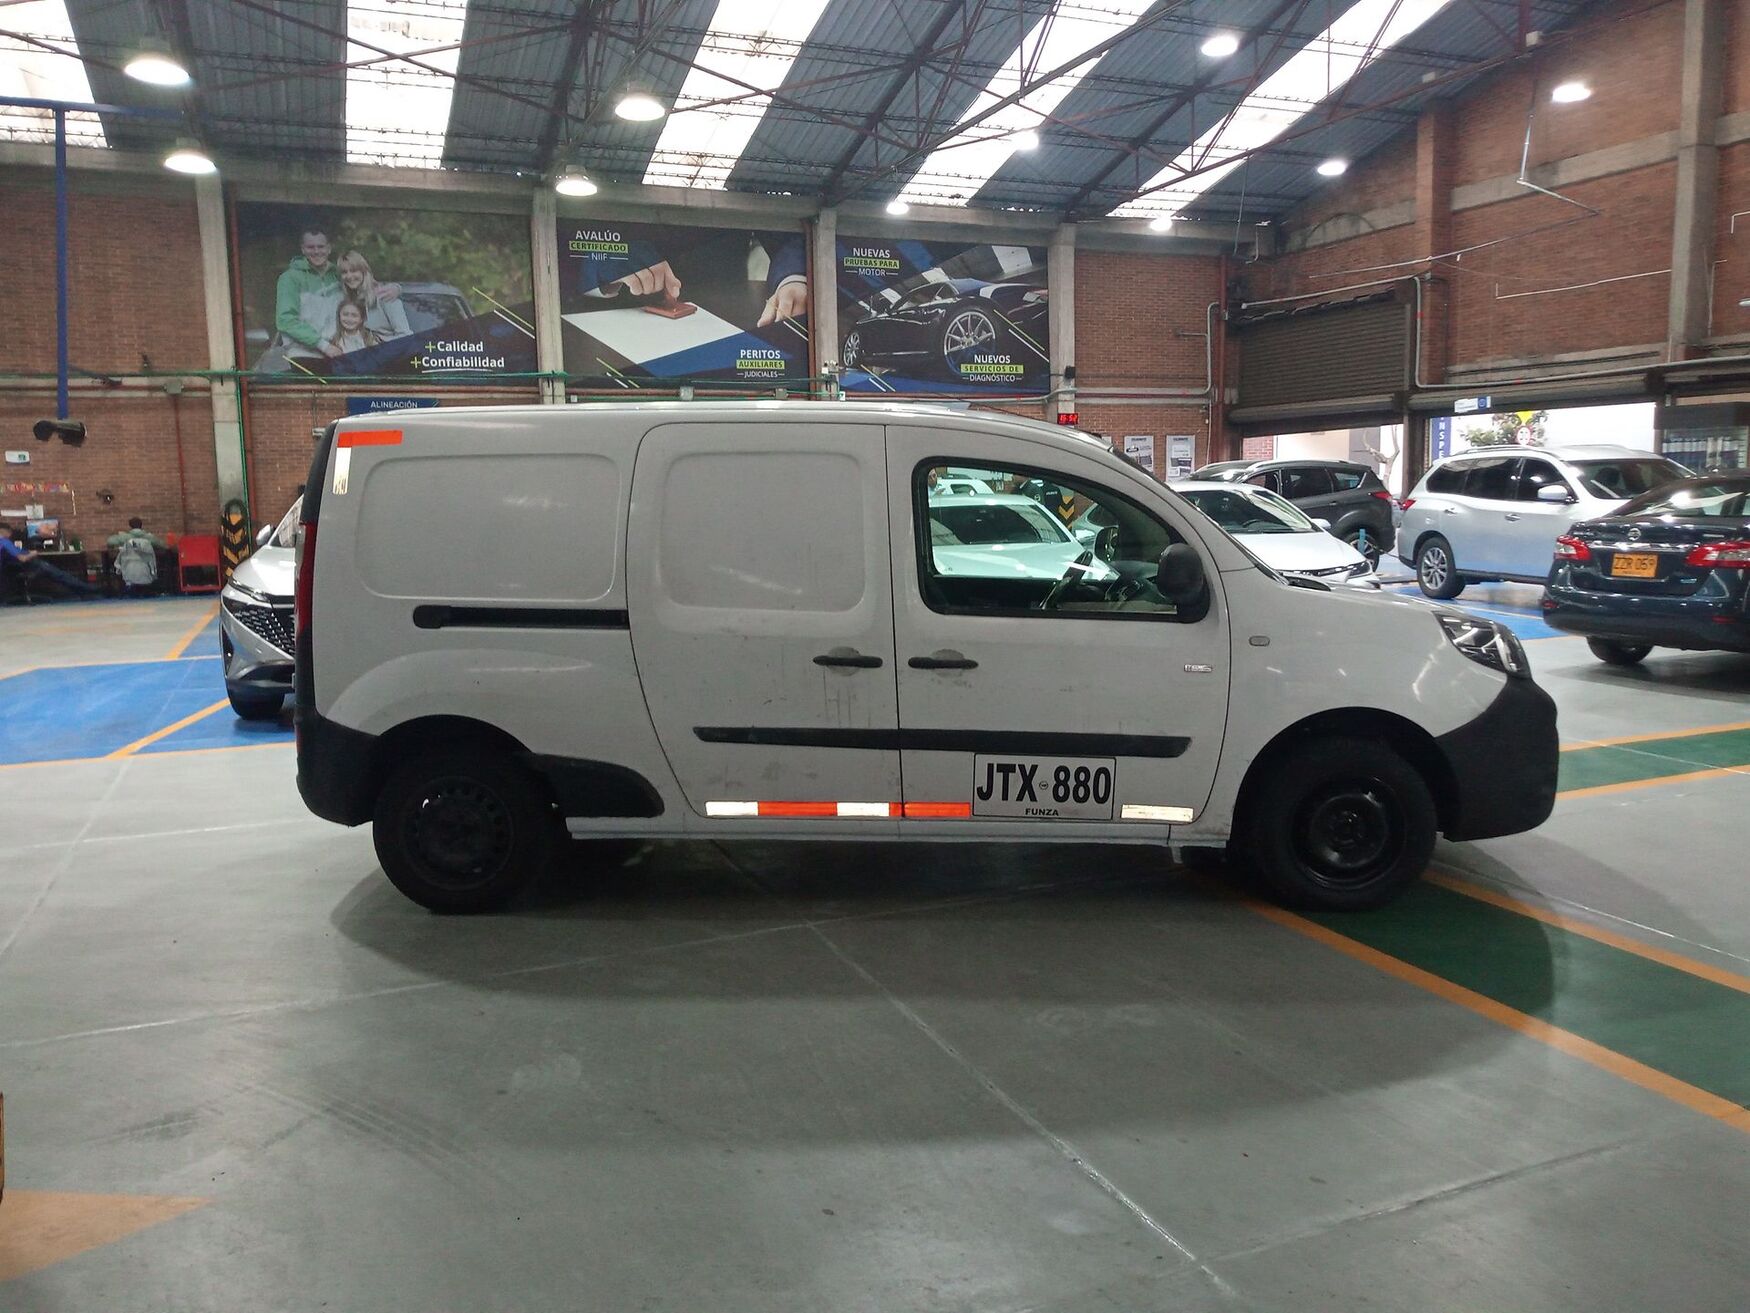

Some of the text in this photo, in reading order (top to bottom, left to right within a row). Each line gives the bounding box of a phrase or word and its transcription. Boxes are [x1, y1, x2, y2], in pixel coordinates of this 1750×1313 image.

[575, 230, 621, 242] AVALÚO
[570, 242, 627, 252] CERTIFICADO
[853, 247, 891, 258] NUEVAS
[845, 258, 898, 268] PRUEBAS PARA
[858, 268, 886, 276] MOTOR
[740, 349, 781, 359] PERITOS
[974, 354, 1011, 364] NUEVOS
[738, 360, 783, 368] AUXILIARES
[964, 365, 1006, 373] SERVICIOS
[744, 370, 778, 379] JUDICIALES
[969, 373, 1016, 382] DIAGNÓSTICO
[370, 399, 418, 409] ALINEACIÓN
[976, 763, 1112, 804] JTX 880
[1025, 808, 1059, 817] FUNZA
